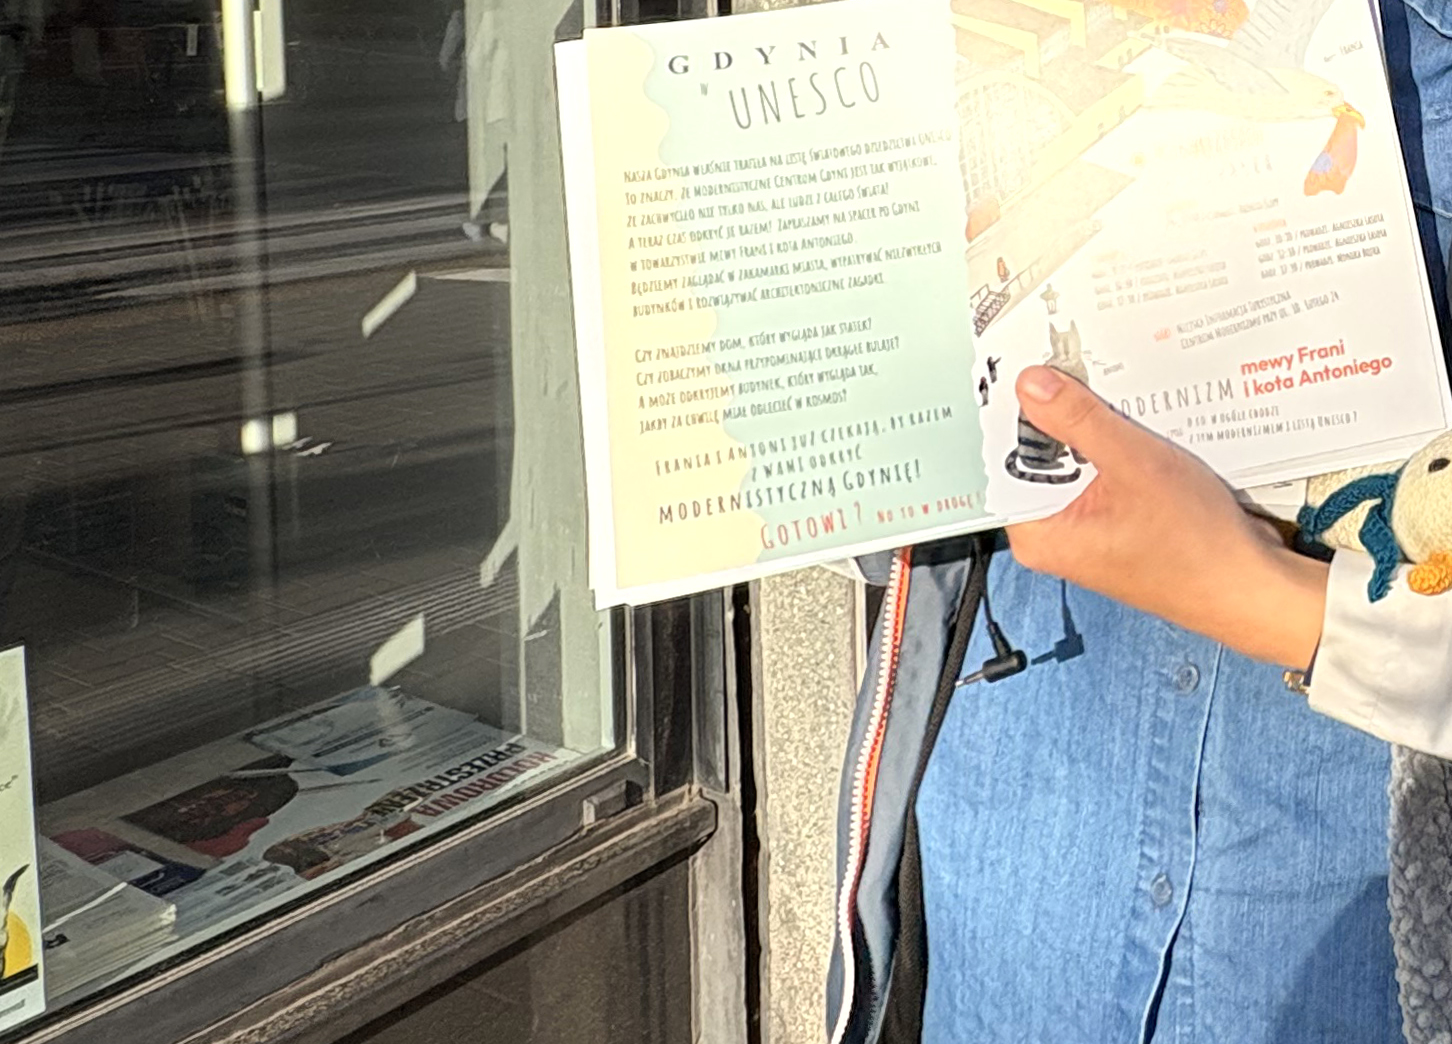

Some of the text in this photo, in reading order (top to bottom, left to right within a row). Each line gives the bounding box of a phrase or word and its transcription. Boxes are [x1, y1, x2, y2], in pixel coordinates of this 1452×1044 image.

[667, 32, 890, 75] GDYNIA
[728, 61, 880, 130] UNESCO
[623, 169, 652, 183] NASZA
[654, 165, 690, 181] GDYNIA
[769, 154, 784, 167] NA
[624, 192, 637, 206] TO
[819, 167, 849, 183] GDYNI
[850, 164, 868, 180] JEST
[869, 162, 885, 175] TAK
[628, 200, 921, 250] A TERAZ CZAS ODKRYĆ JE RAZEM! ZAPRASZAMY NA SPACER PO GDYNI
[698, 206, 715, 219] NIE
[717, 202, 745, 216] TYLKO
[771, 197, 786, 210] ALE
[816, 192, 821, 205] Z
[630, 260, 637, 272] W
[640, 251, 706, 271] TOWARZYSTWIE
[709, 248, 736, 262] MEWY
[739, 243, 768, 258] FRANI
[776, 240, 799, 254] KOTA
[631, 278, 678, 297] BĘDZIEMY
[727, 270, 735, 282] W
[738, 263, 790, 282] ZAKAMARKI
[632, 298, 685, 318] BUDYNKÓW
[760, 278, 845, 300] ARCHITEKTONICZNE
[1204, 290, 1292, 326] INFORMACJA TURYSTYCZNA
[1303, 294, 1330, 311] LUTEGO
[634, 349, 653, 364] CZY
[655, 341, 716, 361] ZNAJDZIEMY
[748, 331, 776, 347] KTÓRY
[778, 326, 819, 343] WYGLĄDA
[821, 324, 837, 338] JAK
[839, 317, 872, 335] STATEK?
[636, 372, 654, 387] CZY
[657, 365, 711, 384] ZOBACZYMY
[714, 359, 742, 375] OKNA
[744, 348, 823, 370] PRZYPOMINAJĄCE
[865, 335, 900, 354] BULAJE?
[1240, 339, 1345, 376] mewy Frani
[638, 395, 645, 409] A
[679, 383, 735, 404] ODKRYJEMY
[787, 371, 814, 388] KTÓRY
[817, 366, 857, 383] WYGLĄDA
[1243, 356, 1393, 398] i kota Antoniego
[639, 417, 667, 435] JAKBY
[671, 415, 683, 429] ZA
[685, 409, 720, 427] CHWILĘ
[795, 397, 803, 409] W
[805, 388, 847, 408] KOSMOS?
[1118, 377, 1234, 422] ODERNIZM
[655, 452, 711, 476] FRANIA
[728, 437, 787, 461] ANTONI
[890, 415, 904, 430] BY
[909, 406, 953, 426] RAZEM
[1195, 415, 1207, 427] CO
[1196, 432, 1214, 442] TYM
[1216, 422, 1284, 441] MODERNIZMEM
[751, 443, 862, 483] Z WAMI ODKRYĆ
[659, 458, 920, 525] MODERNISTYCZNĄ GDYNIĘ!
[760, 501, 929, 550] GOTOWI? NO TO W
